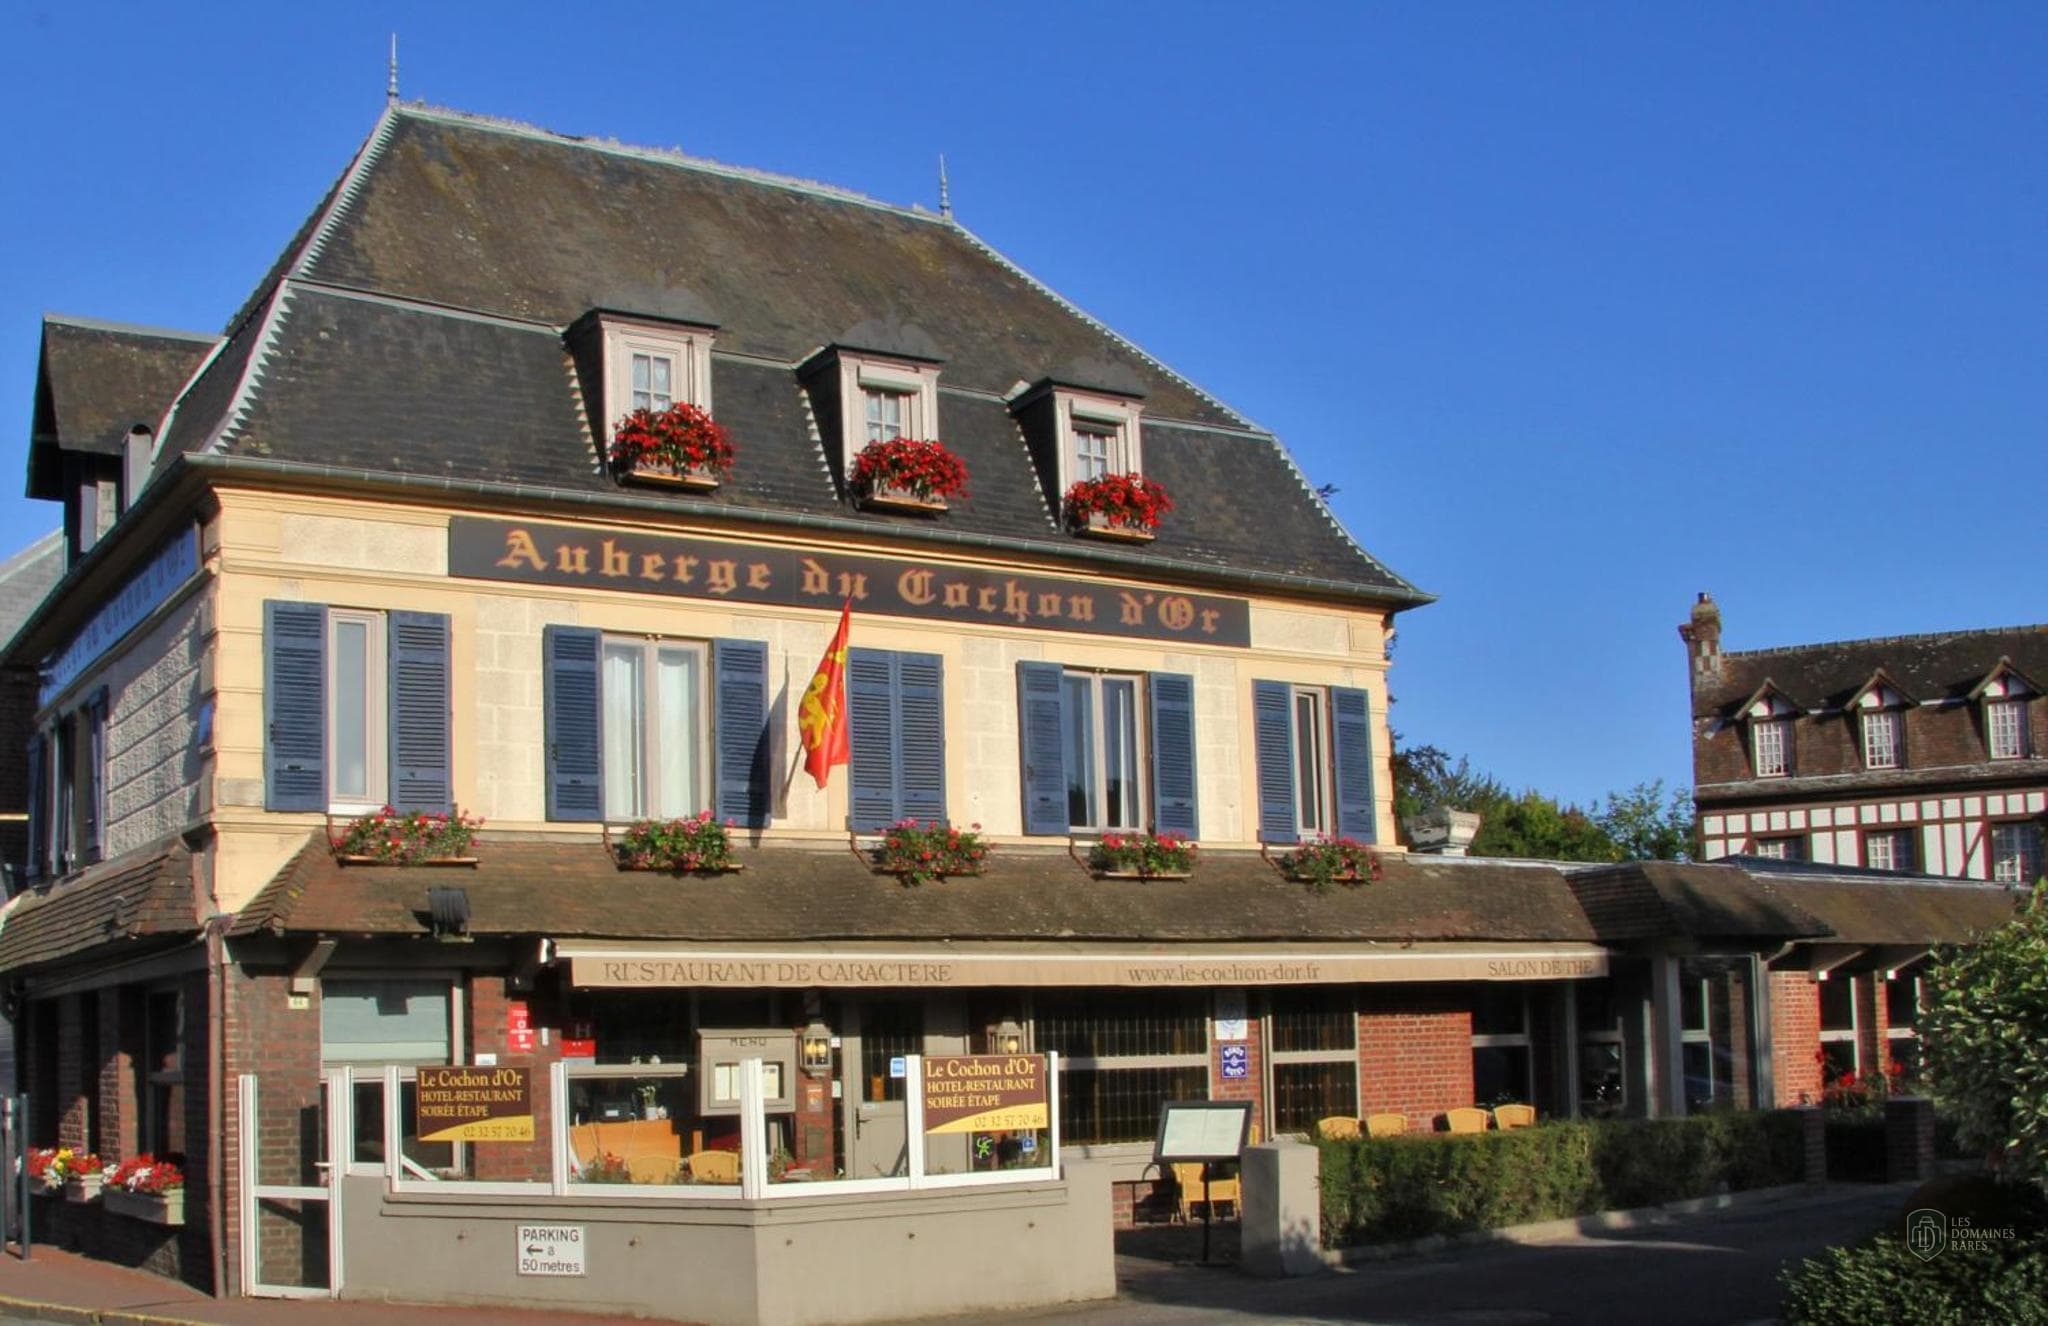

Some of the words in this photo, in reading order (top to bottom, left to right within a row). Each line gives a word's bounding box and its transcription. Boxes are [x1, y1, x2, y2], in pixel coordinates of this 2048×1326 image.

[497, 527, 772, 595] Auberge
[801, 558, 869, 600] du
[899, 568, 1095, 623] Cochon
[1120, 590, 1221, 635] d'Or
[603, 962, 772, 982] RESTAURANT
[777, 963, 811, 982] DE
[1487, 961, 1538, 977] SALON
[1540, 960, 1561, 976] DE
[926, 1060, 943, 1077] Le
[947, 1059, 1001, 1077] Cochon
[1005, 1058, 1036, 1075] d'Or
[420, 1071, 436, 1087] Le
[439, 1070, 489, 1087] Cochon
[493, 1069, 523, 1086] d'Or
[927, 1078, 1035, 1093] HOTEL-RESTAURANT
[421, 1089, 523, 1102] HOTEL-RESTAURANT
[927, 1094, 963, 1109] SOIRÉE
[967, 1093, 1000, 1107] ÉTAPE
[421, 1103, 454, 1117] SOIRÉE
[457, 1103, 488, 1117] ÉTAPE
[523, 1229, 579, 1242] PARKING
[522, 1259, 538, 1271] 50
[540, 1260, 580, 1272] metres
